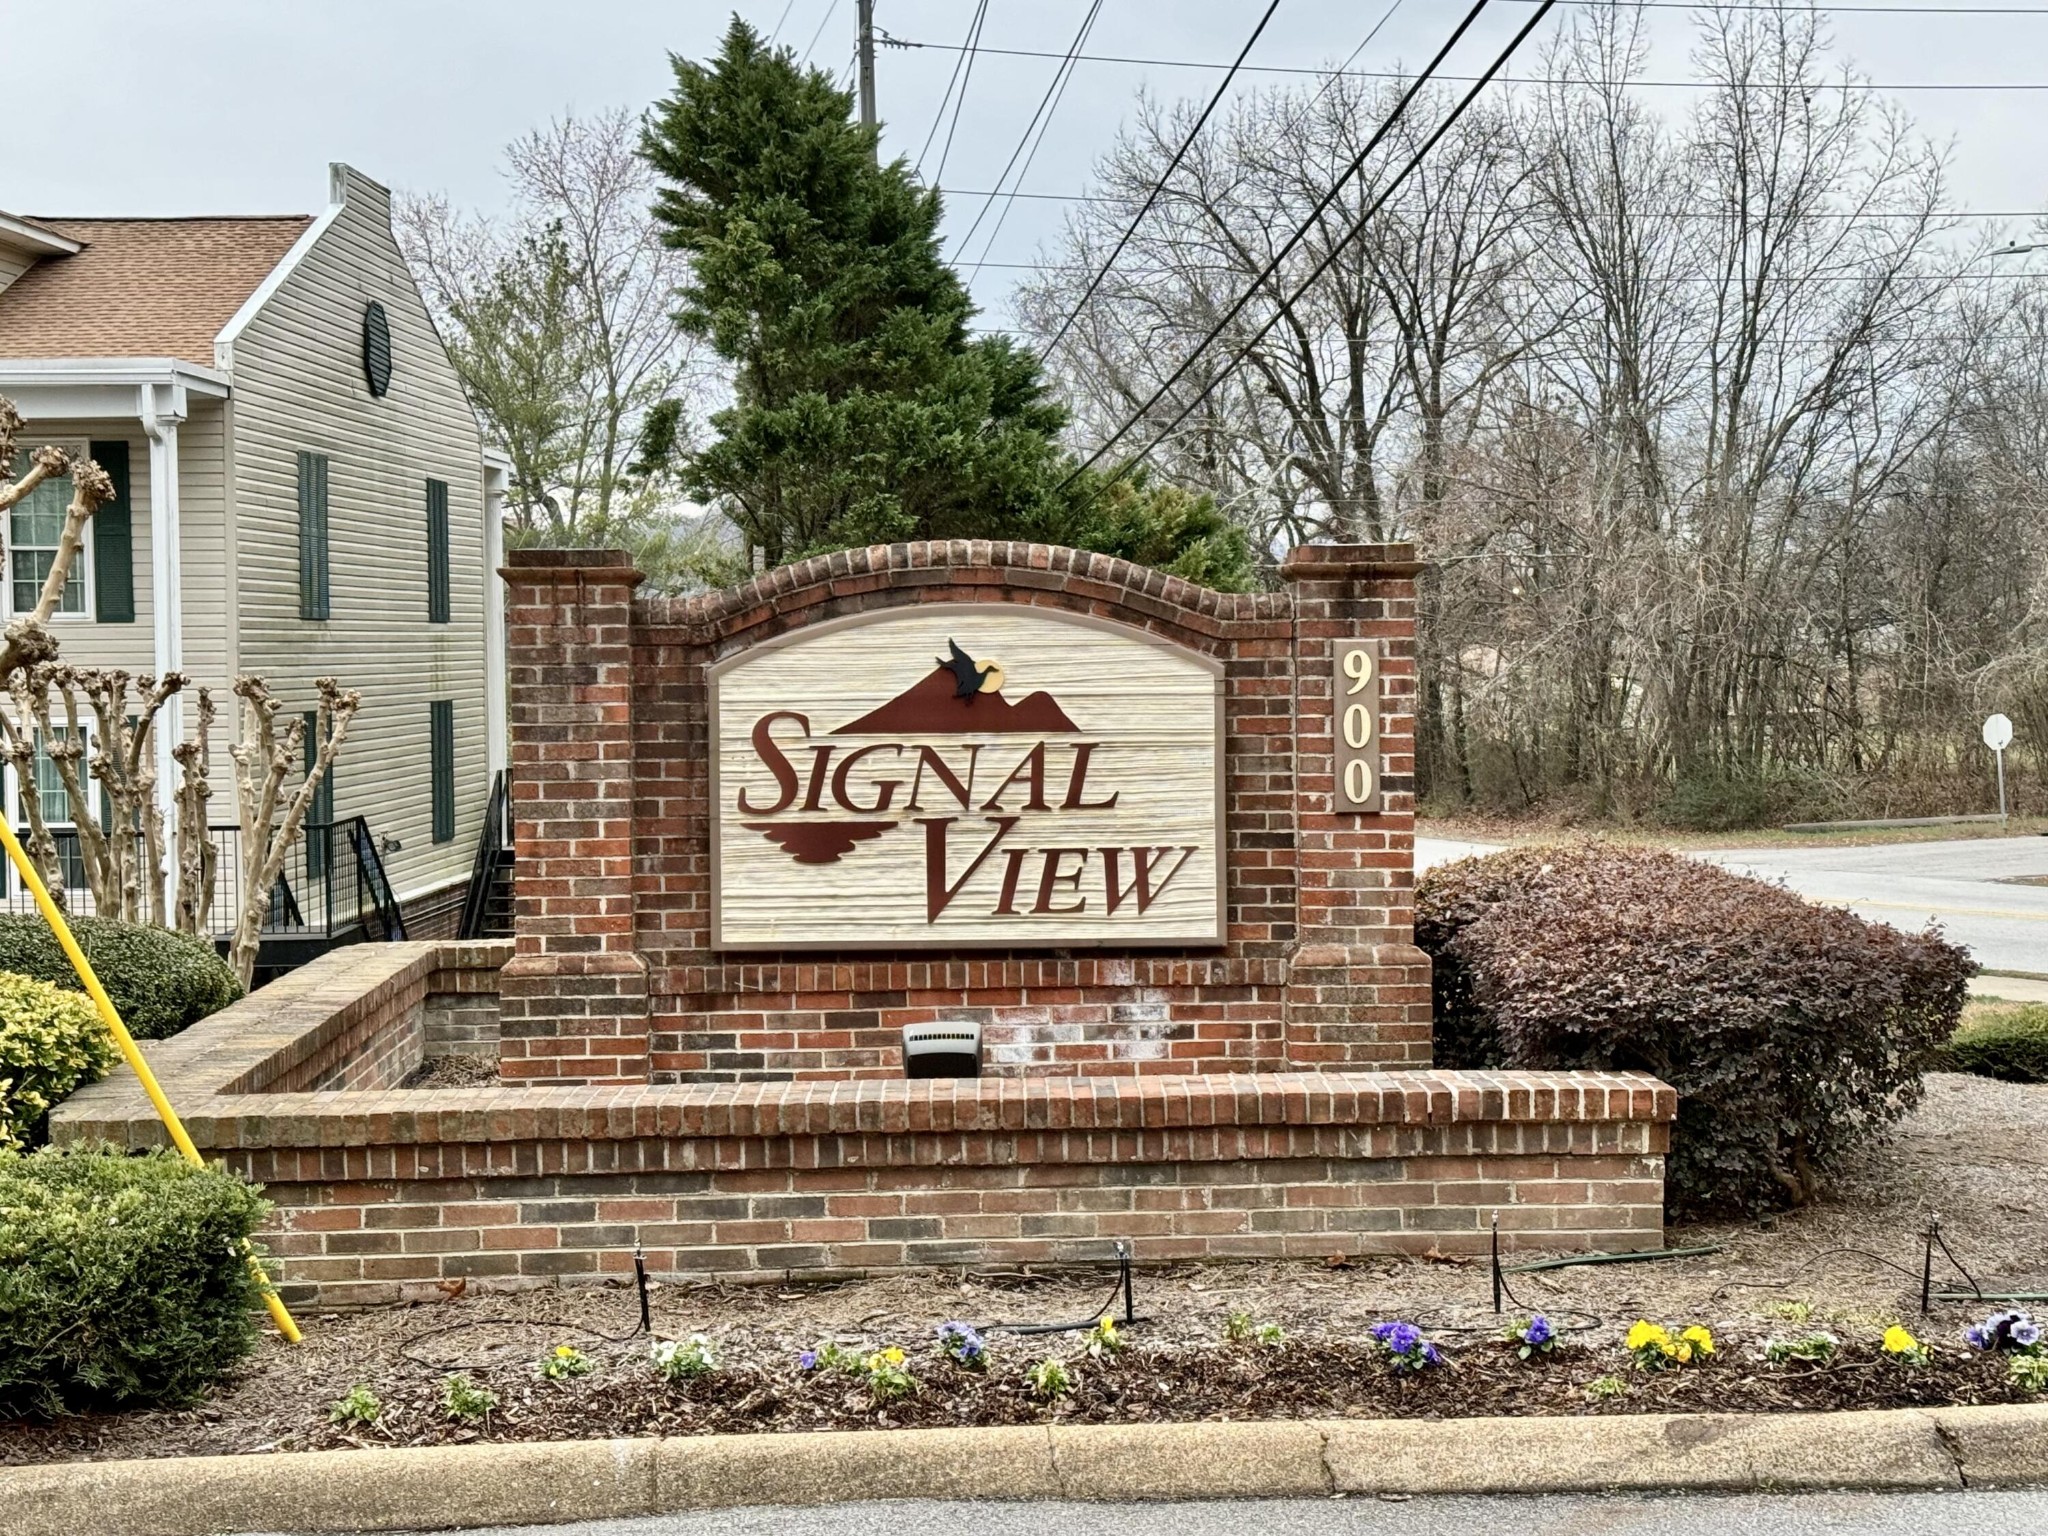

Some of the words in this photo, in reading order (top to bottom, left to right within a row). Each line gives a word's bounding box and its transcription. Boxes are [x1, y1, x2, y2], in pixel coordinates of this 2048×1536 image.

[737, 711, 1119, 814] SIGNAL
[1343, 650, 1372, 804] 900
[913, 816, 1200, 924] VIEW
